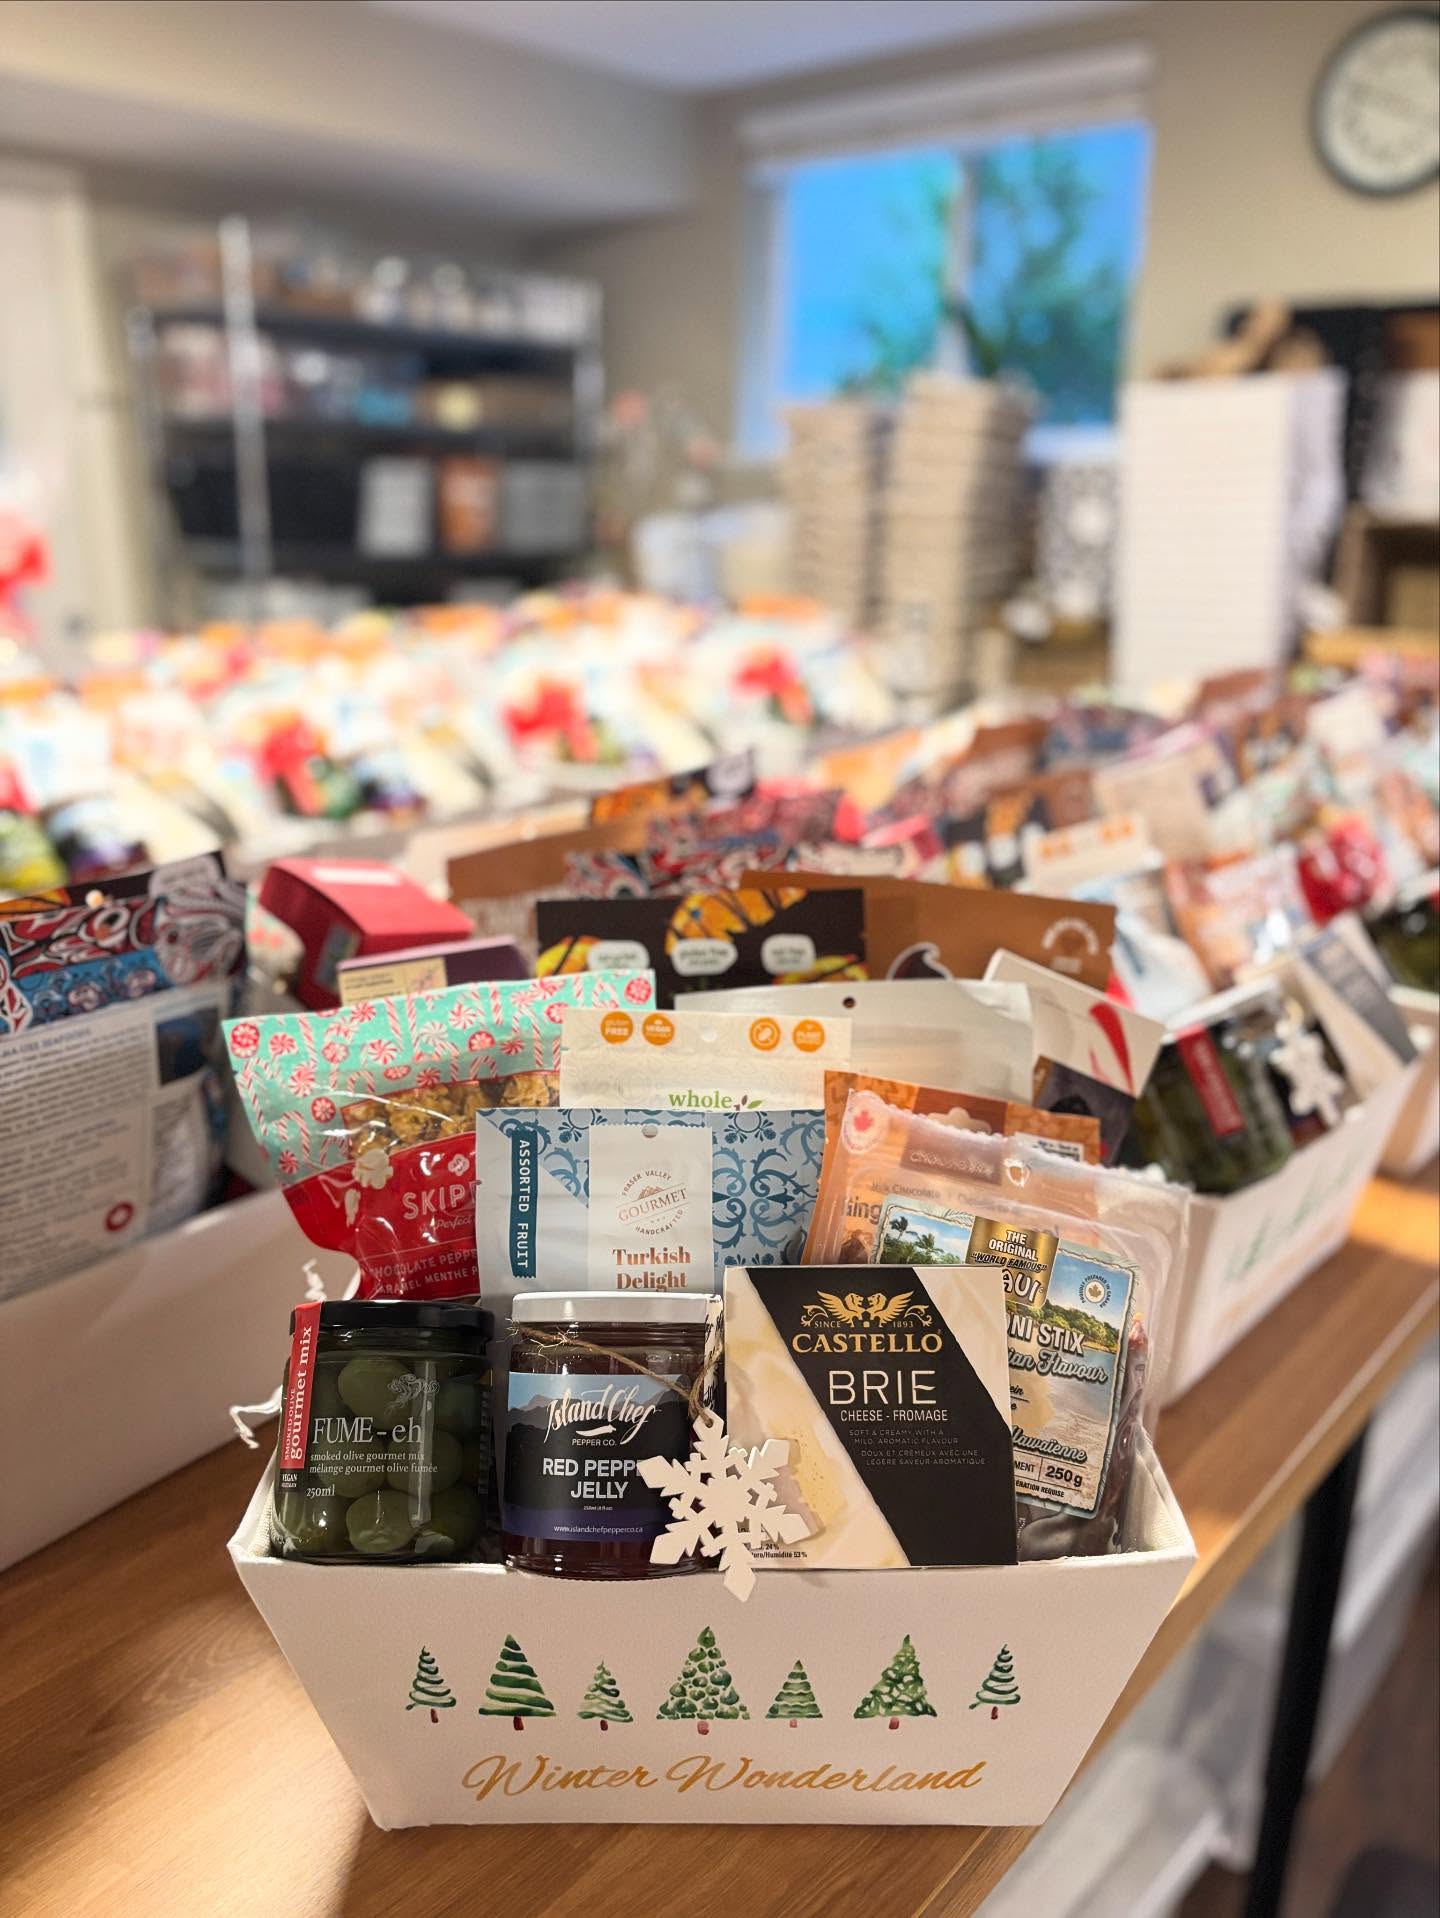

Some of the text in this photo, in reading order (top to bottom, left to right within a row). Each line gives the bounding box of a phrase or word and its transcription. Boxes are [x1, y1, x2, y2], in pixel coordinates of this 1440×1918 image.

[604, 1026, 629, 1036] FREE
[668, 1089, 733, 1109] whole
[621, 1170, 673, 1197] FRASER VALLEY
[516, 1139, 532, 1269] ASSORTED FRUIT
[617, 1187, 688, 1223] GOURMET
[635, 1209, 684, 1236] HANDCRAFTED
[1005, 1230, 1028, 1246] THE
[612, 1246, 692, 1266] Turkish
[988, 1239, 1039, 1262] ORIGINAL
[375, 1279, 422, 1296] ARAMEL
[424, 1267, 469, 1283] MENTHE
[616, 1270, 689, 1293] Delight
[813, 1320, 915, 1329] SINCE 1893
[1008, 1312, 1086, 1357] NI STIX
[791, 1333, 944, 1354] CASTELLO
[1037, 1348, 1109, 1384] Flavour
[290, 1325, 313, 1461] gourmet mix
[828, 1369, 938, 1406] BRIE
[288, 1388, 296, 1417] OLIVE
[543, 1383, 662, 1445] Island Chef
[840, 1410, 883, 1422] CHEESE
[893, 1409, 949, 1422] FROMAGE
[311, 1416, 374, 1444] FUME
[391, 1416, 424, 1443] eh
[571, 1438, 617, 1447] PEPPER CO.
[878, 1437, 919, 1445] AROMATIC
[921, 1437, 959, 1445] FLAVOUR
[310, 1450, 425, 1465] smoked olive gourmet mix
[899, 1458, 930, 1466] SAVEUR
[932, 1457, 986, 1466] AROMATIQUE
[938, 1449, 960, 1457] AVEC
[309, 1461, 438, 1476] mélange gourmet olive fumée
[542, 1457, 641, 1477] RED PEPP
[1045, 1465, 1084, 1488] 250 g
[282, 1473, 298, 1482] VEGAN
[306, 1484, 335, 1499] 250ml
[570, 1481, 629, 1499] JELLY
[1040, 1486, 1065, 1498] REQUISE
[553, 1525, 643, 1535] www.islandchefpepperco.ca
[751, 1551, 793, 1560] ure/Humidité
[765, 1543, 773, 1551] 24
[460, 1754, 989, 1801] Winter Wonderland
